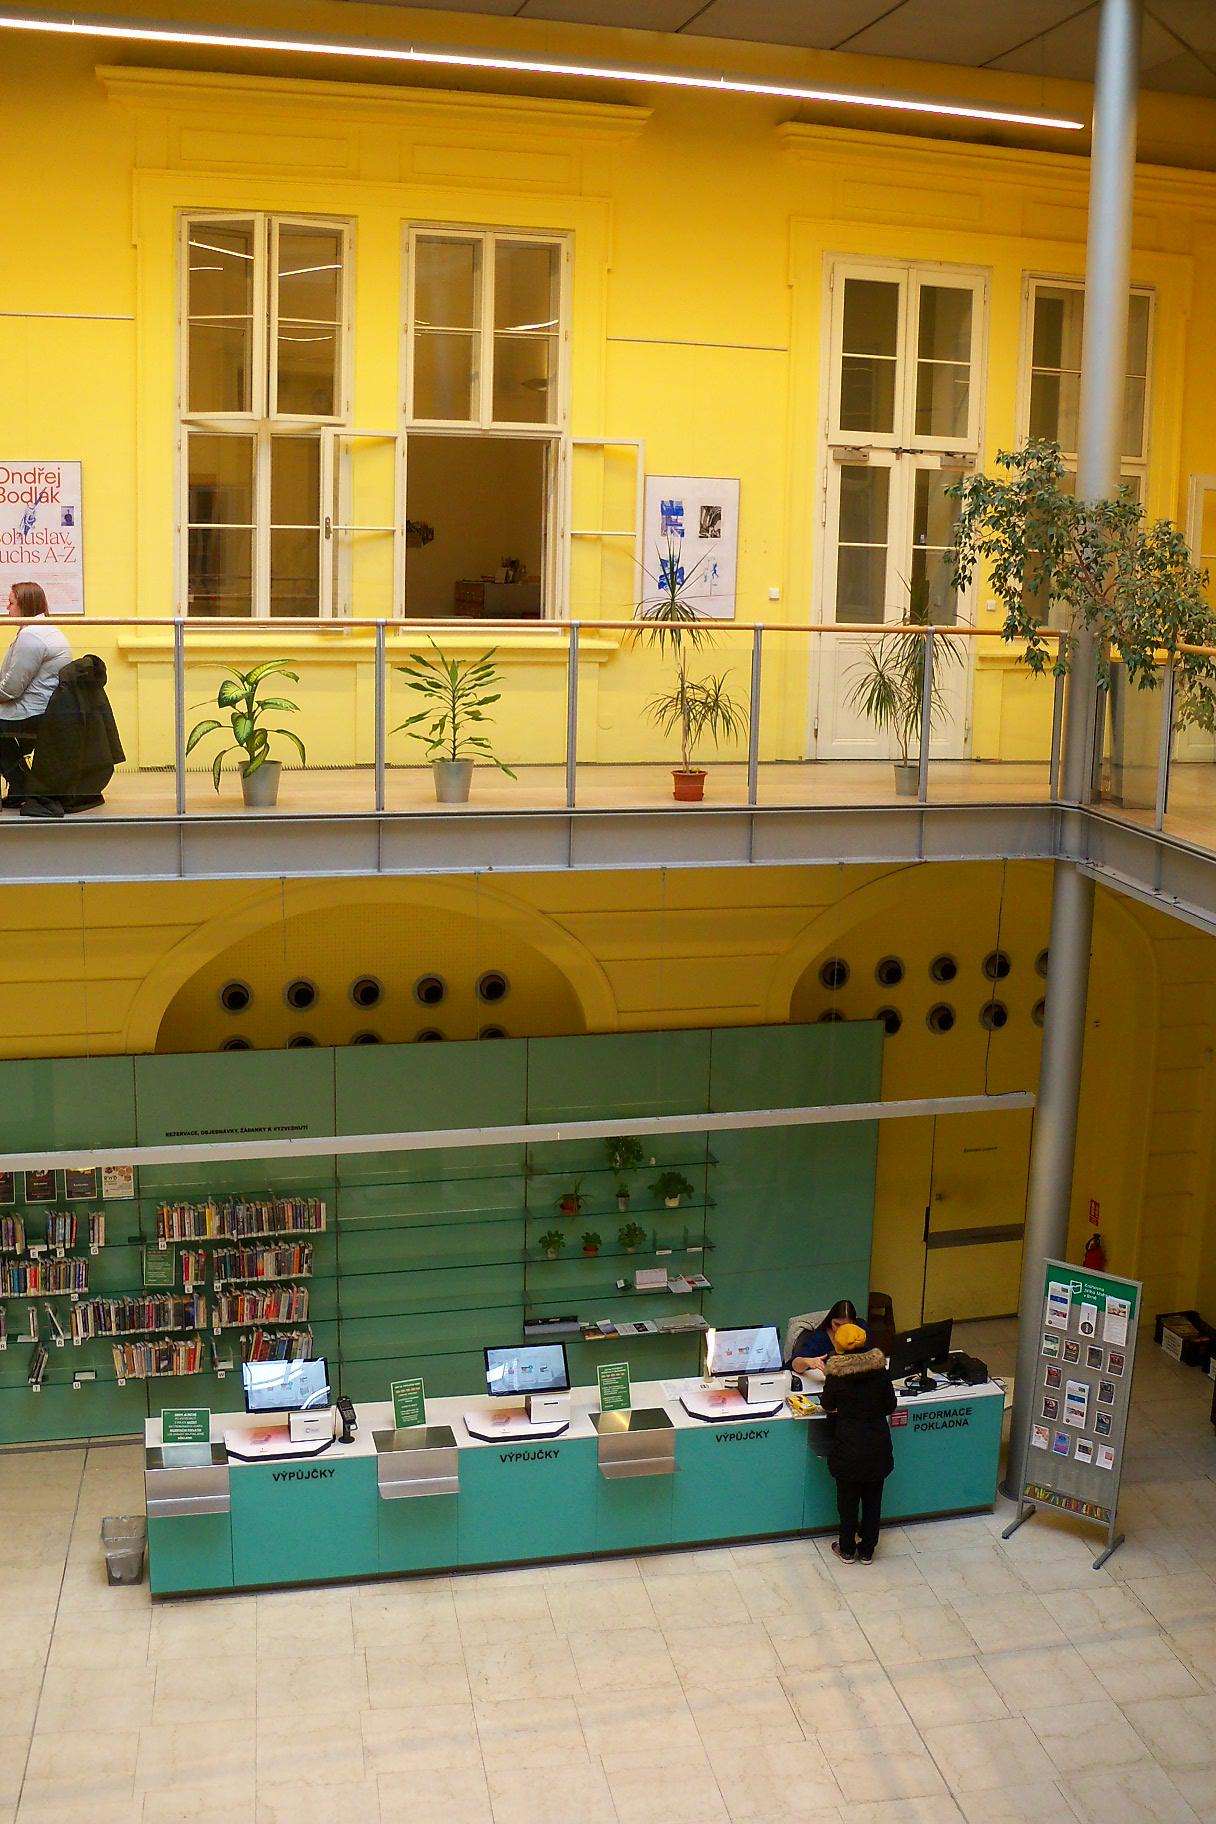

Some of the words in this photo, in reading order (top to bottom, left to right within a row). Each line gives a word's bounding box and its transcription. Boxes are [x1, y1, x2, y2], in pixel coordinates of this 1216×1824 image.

[0, 466, 61, 489] Ondřej
[0, 527, 70, 546] ohuslav
[0, 546, 41, 564] uchs
[912, 1407, 973, 1422] INFORMACE
[913, 1418, 969, 1432] POKLADNA
[715, 1429, 770, 1443] VÝPŮJČKY
[499, 1449, 561, 1464] VÝPŮJČKY
[272, 1468, 336, 1483] VÝPŮJČKY
